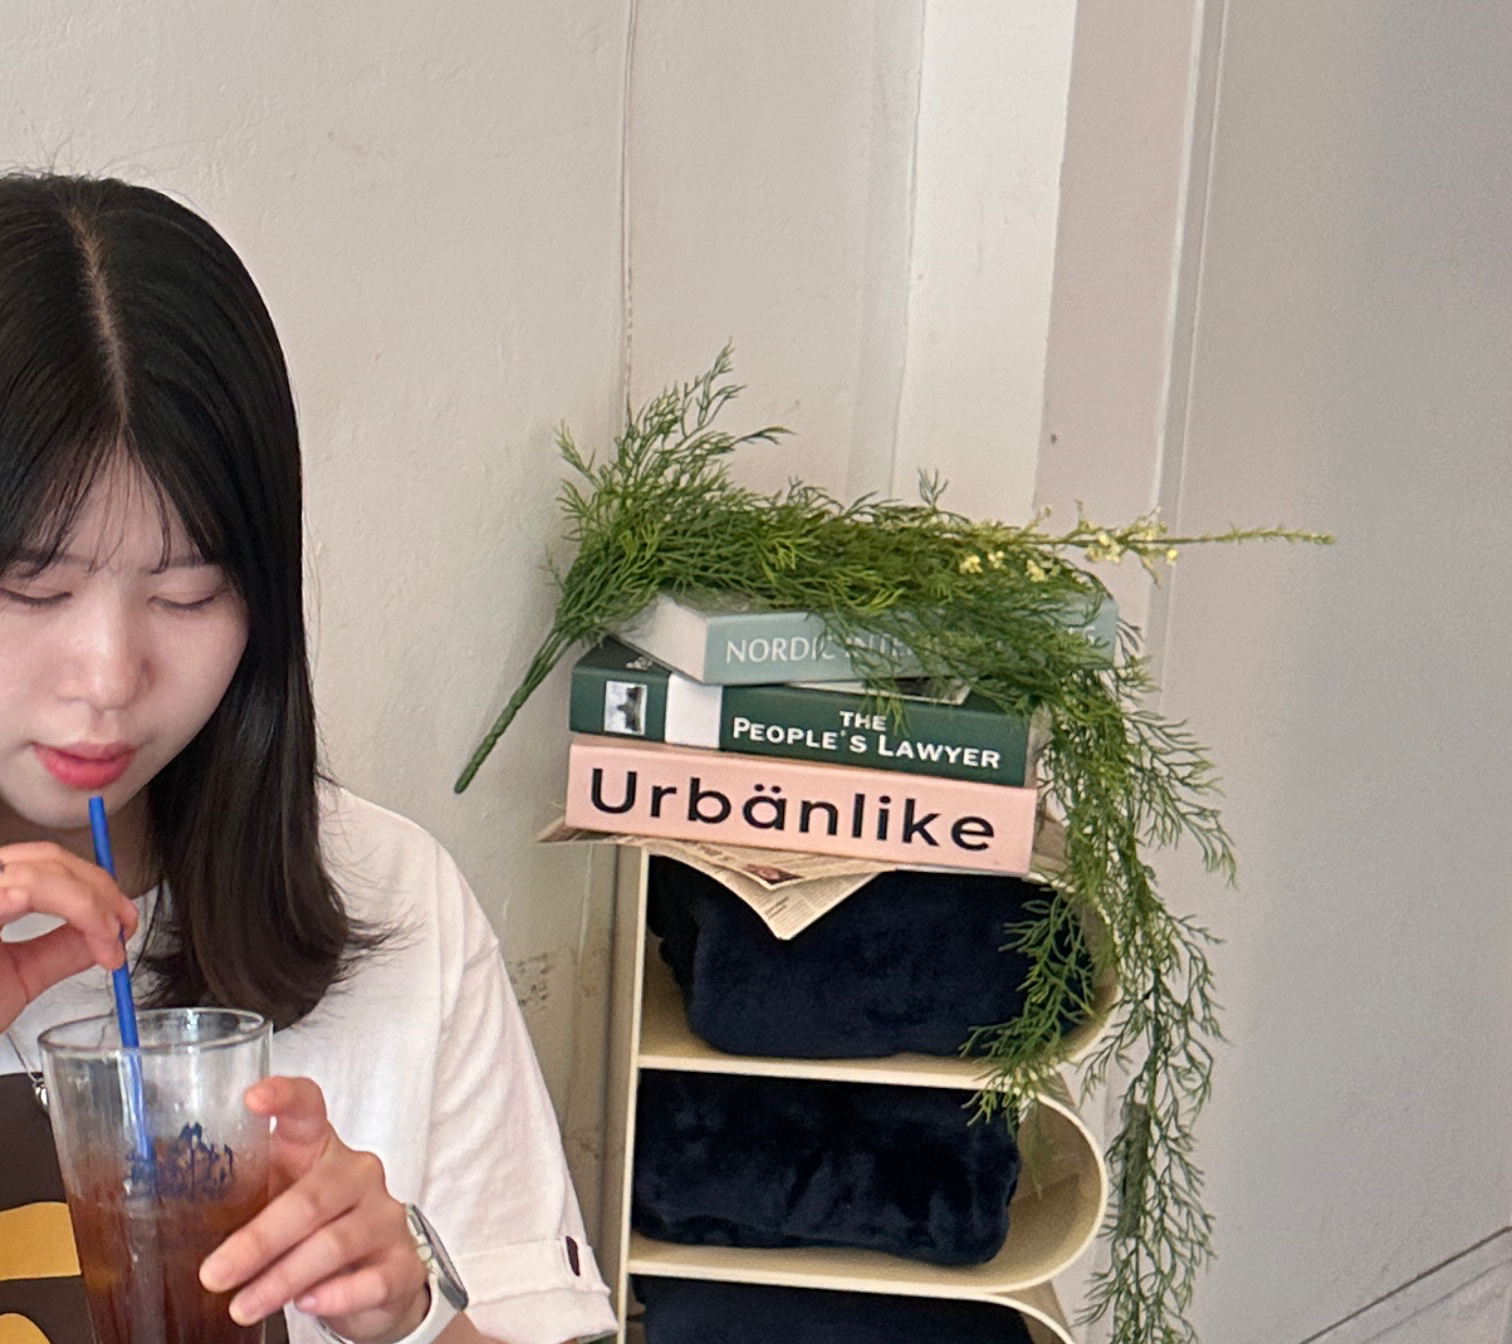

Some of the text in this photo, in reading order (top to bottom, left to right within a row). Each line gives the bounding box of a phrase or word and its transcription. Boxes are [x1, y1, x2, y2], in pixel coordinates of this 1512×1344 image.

[725, 636, 836, 664] NORDIC
[839, 710, 887, 732] THE
[877, 733, 1001, 770] LAWYER
[590, 767, 995, 852] Urbänlike
